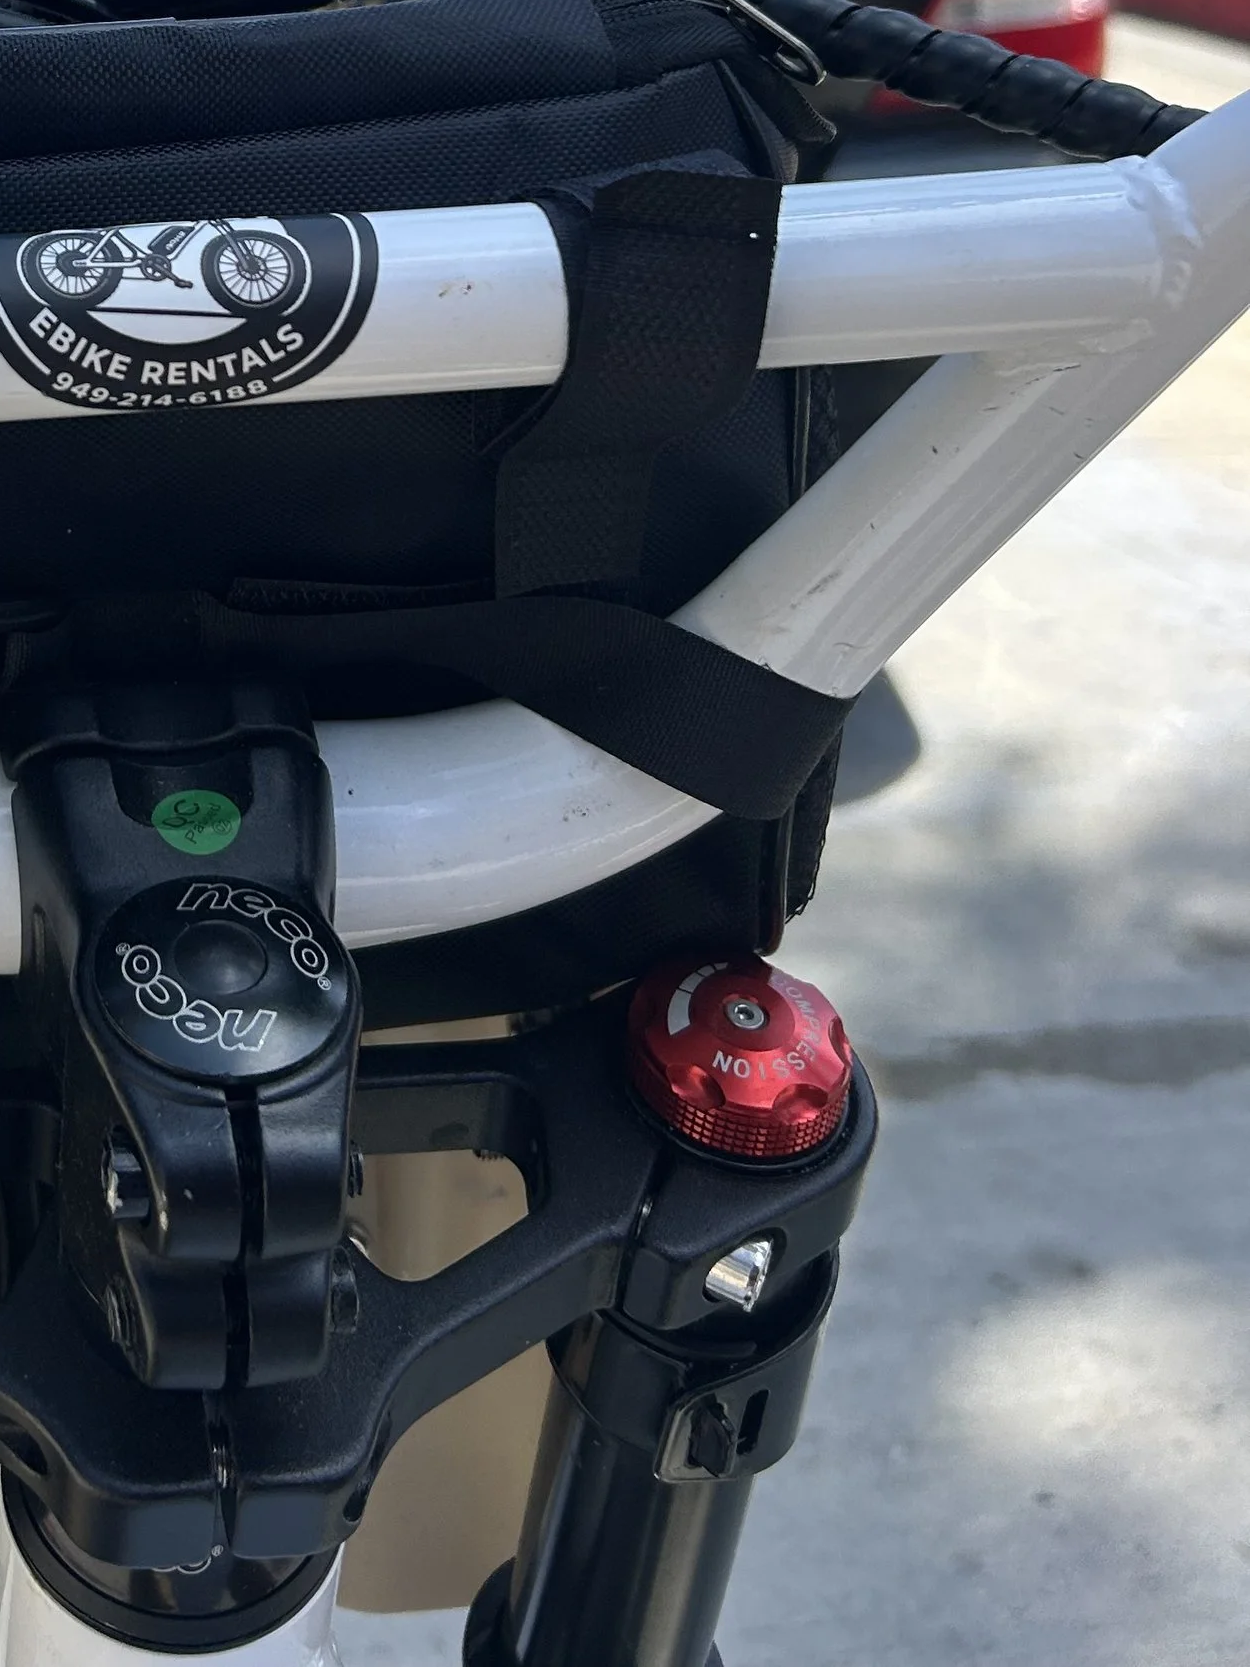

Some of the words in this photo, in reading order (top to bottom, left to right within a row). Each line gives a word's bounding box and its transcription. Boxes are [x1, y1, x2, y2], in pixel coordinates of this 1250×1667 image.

[29, 307, 132, 380] EBIKE
[140, 323, 304, 385] RENTALS
[51, 371, 269, 408] 949-214-6188
[161, 799, 200, 829] QC
[712, 974, 821, 1081] COMPRESSION
